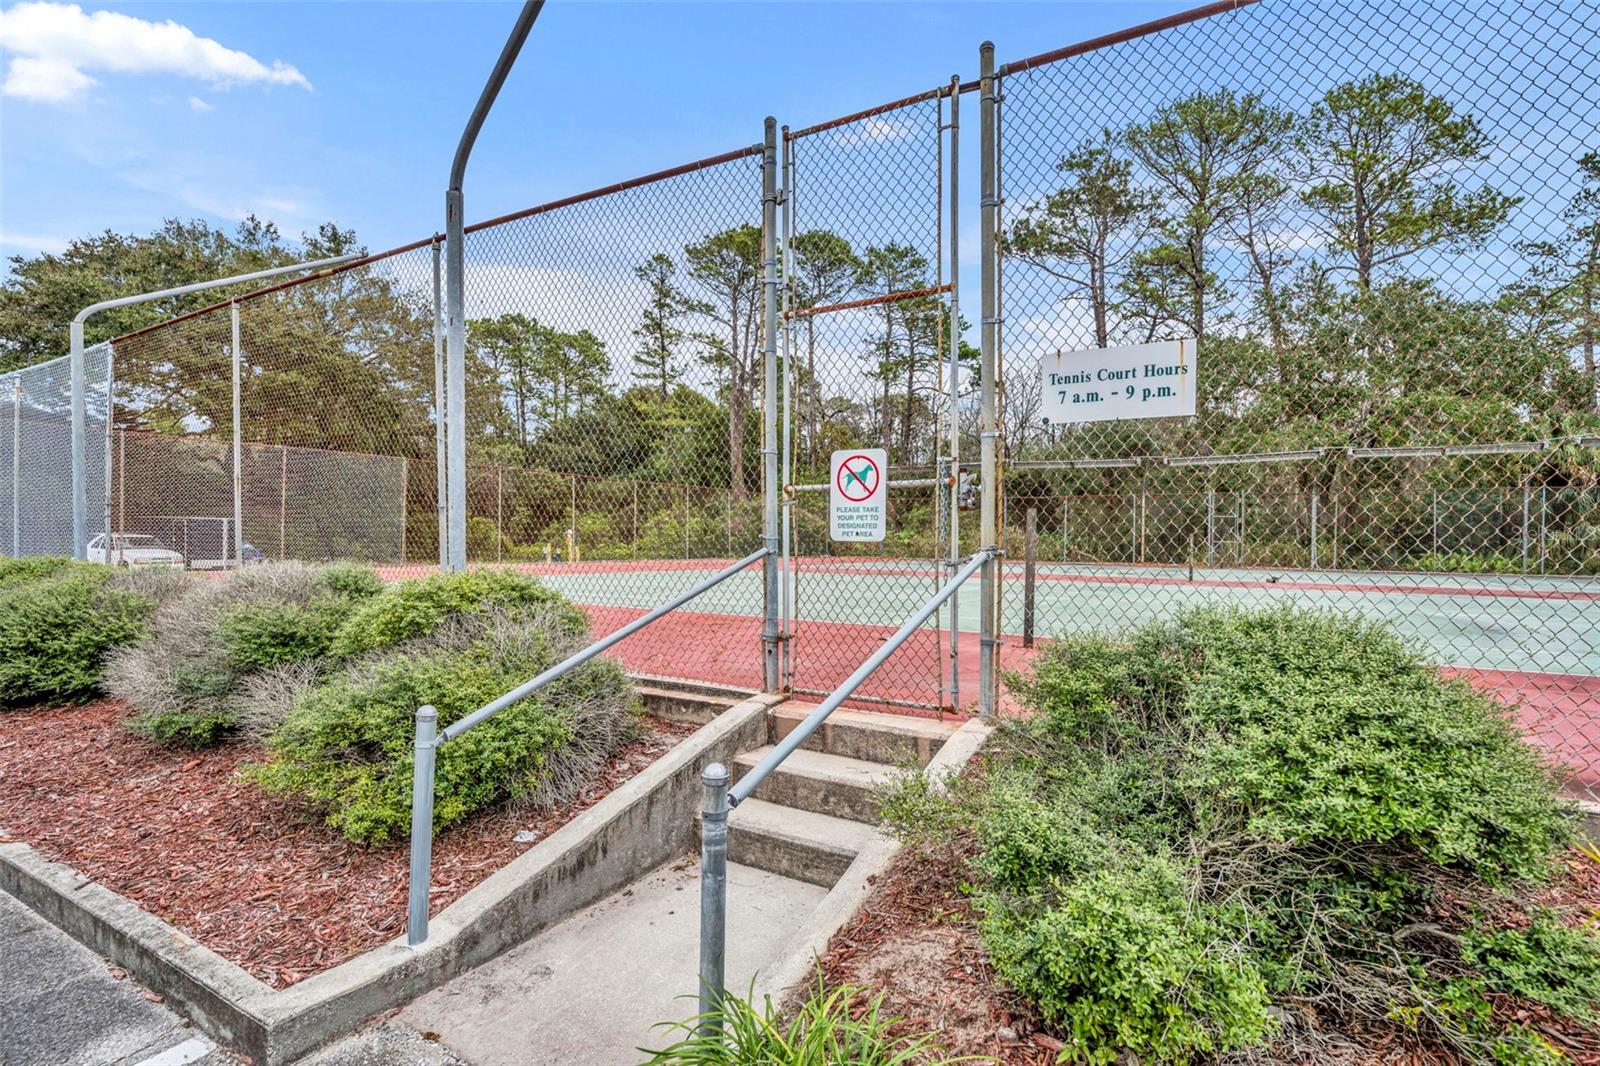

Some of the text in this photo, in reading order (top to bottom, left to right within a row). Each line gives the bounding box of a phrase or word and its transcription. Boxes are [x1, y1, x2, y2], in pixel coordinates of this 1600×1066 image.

[1049, 364, 1188, 386] Tennis Court Hours
[1058, 391, 1066, 404] 7
[1072, 392, 1104, 403] a.m.
[1126, 386, 1134, 399] 9
[1142, 386, 1176, 402] p.m.
